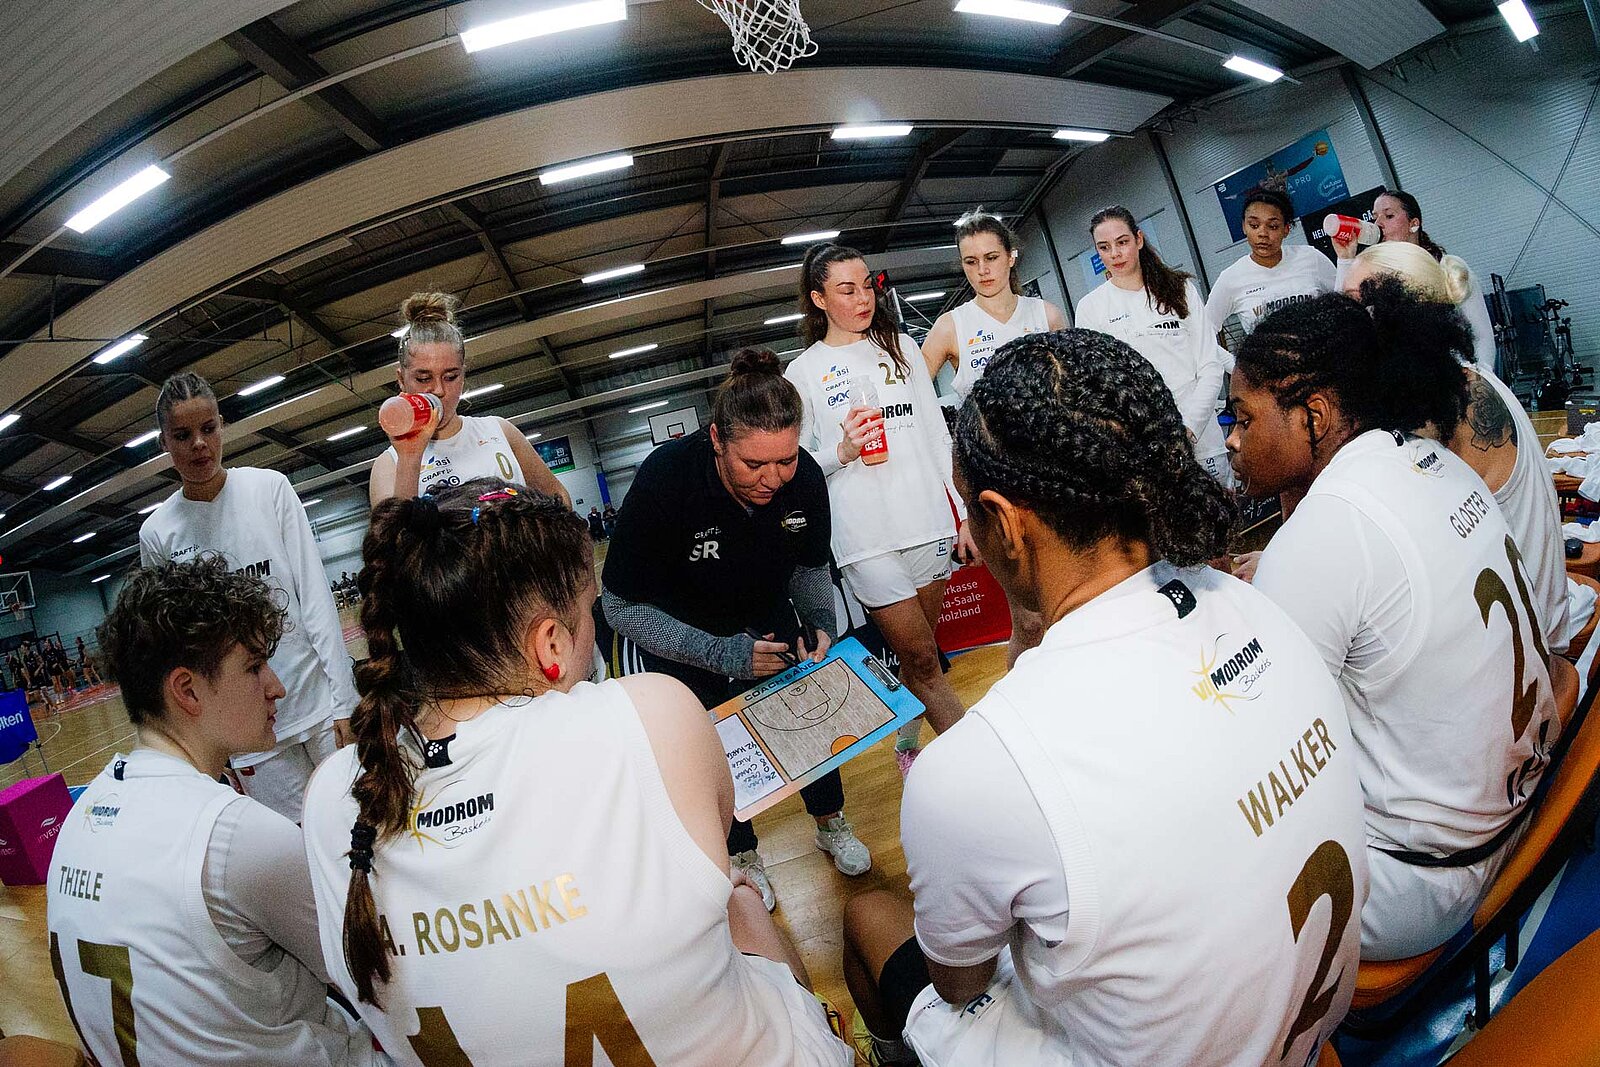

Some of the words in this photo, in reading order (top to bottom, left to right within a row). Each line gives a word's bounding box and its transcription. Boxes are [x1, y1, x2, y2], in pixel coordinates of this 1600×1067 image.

[1312, 228, 1328, 240] HEI
[982, 332, 995, 342] asi
[836, 366, 850, 378] asi
[435, 456, 451, 467] asi
[496, 452, 514, 480] 0
[1450, 491, 1490, 539] GLOSTER
[688, 540, 721, 562] SR
[1239, 658, 1272, 693] Baskets
[744, 678, 785, 702] COACH
[1236, 717, 1337, 837] WALKER
[59, 866, 103, 902] THIELE
[412, 872, 589, 955] ROSANKE
[1285, 840, 1354, 1062] 2
